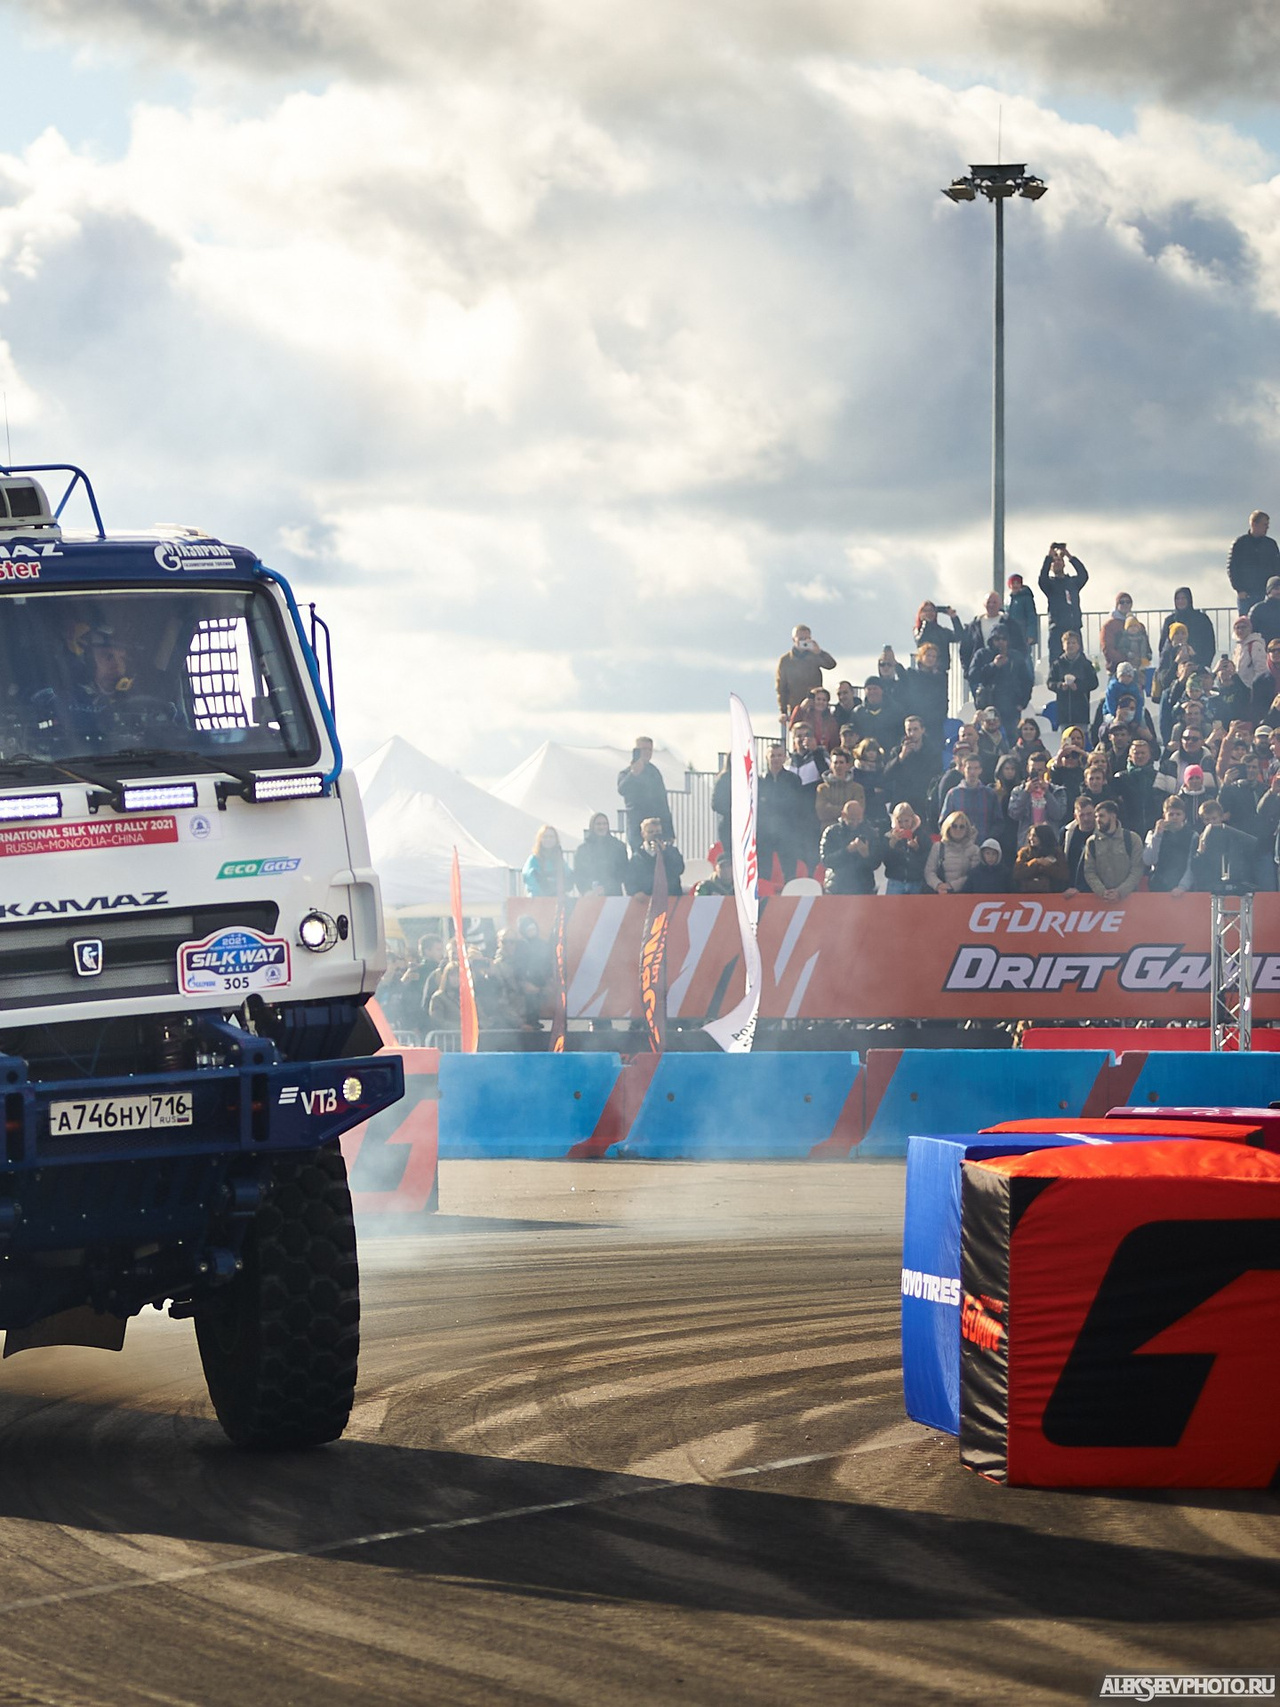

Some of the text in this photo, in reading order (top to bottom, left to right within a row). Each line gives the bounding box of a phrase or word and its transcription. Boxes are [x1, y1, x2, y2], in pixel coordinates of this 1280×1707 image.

[173, 545, 231, 557] ГАЗПРОМ
[62, 825, 85, 837] SILK
[87, 823, 112, 834] WAY
[115, 820, 148, 832] RALLY
[150, 819, 173, 830] 2021
[191, 947, 280, 968] SILK WAY
[218, 965, 255, 973] RALLY
[946, 946, 1120, 989] DRIFT
[224, 977, 249, 990] 305
[152, 1096, 186, 1117] 716
[301, 1088, 337, 1115] VTB
